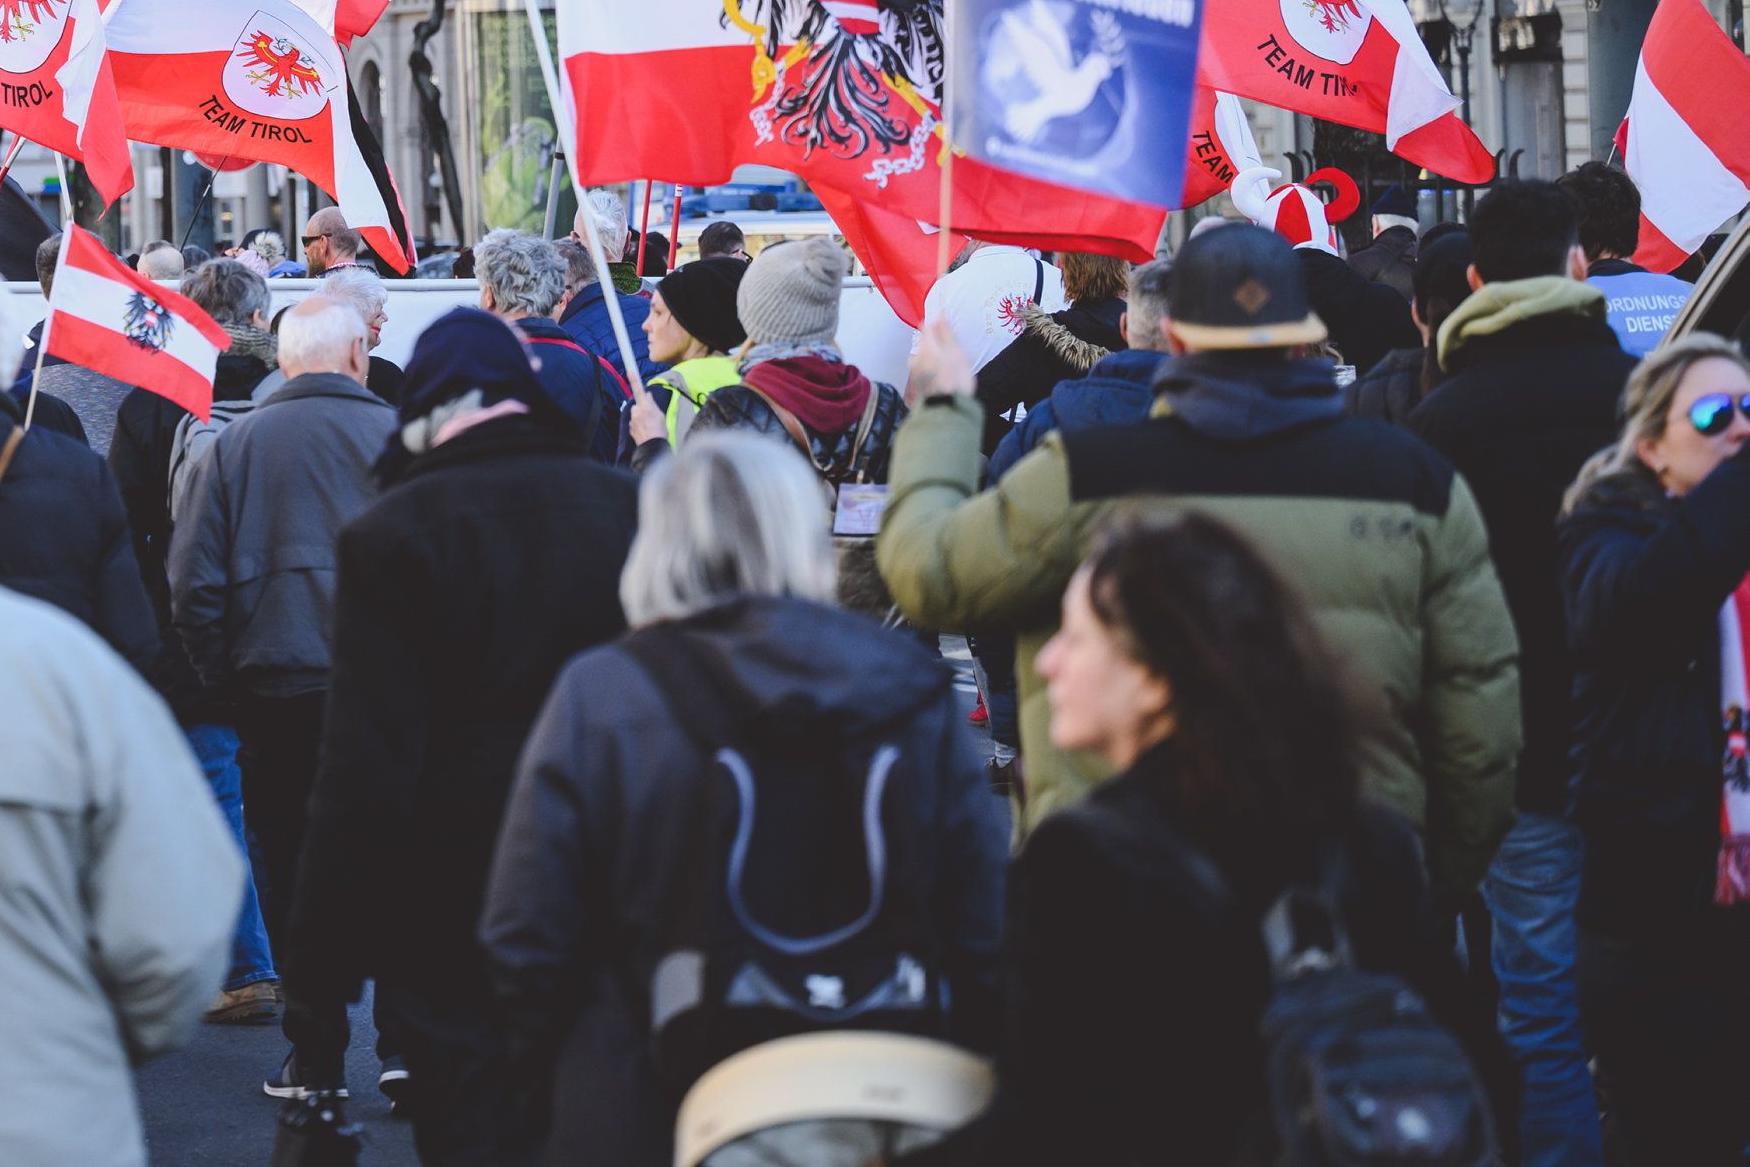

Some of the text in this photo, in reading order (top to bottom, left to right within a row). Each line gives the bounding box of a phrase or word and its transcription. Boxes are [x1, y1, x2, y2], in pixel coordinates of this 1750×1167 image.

[1257, 34, 1315, 90] TEAM
[1, 80, 53, 107] TIROL
[199, 94, 313, 143] TEAM TIROL
[1193, 130, 1234, 184] TEAM
[1625, 315, 1676, 333] DIENS
